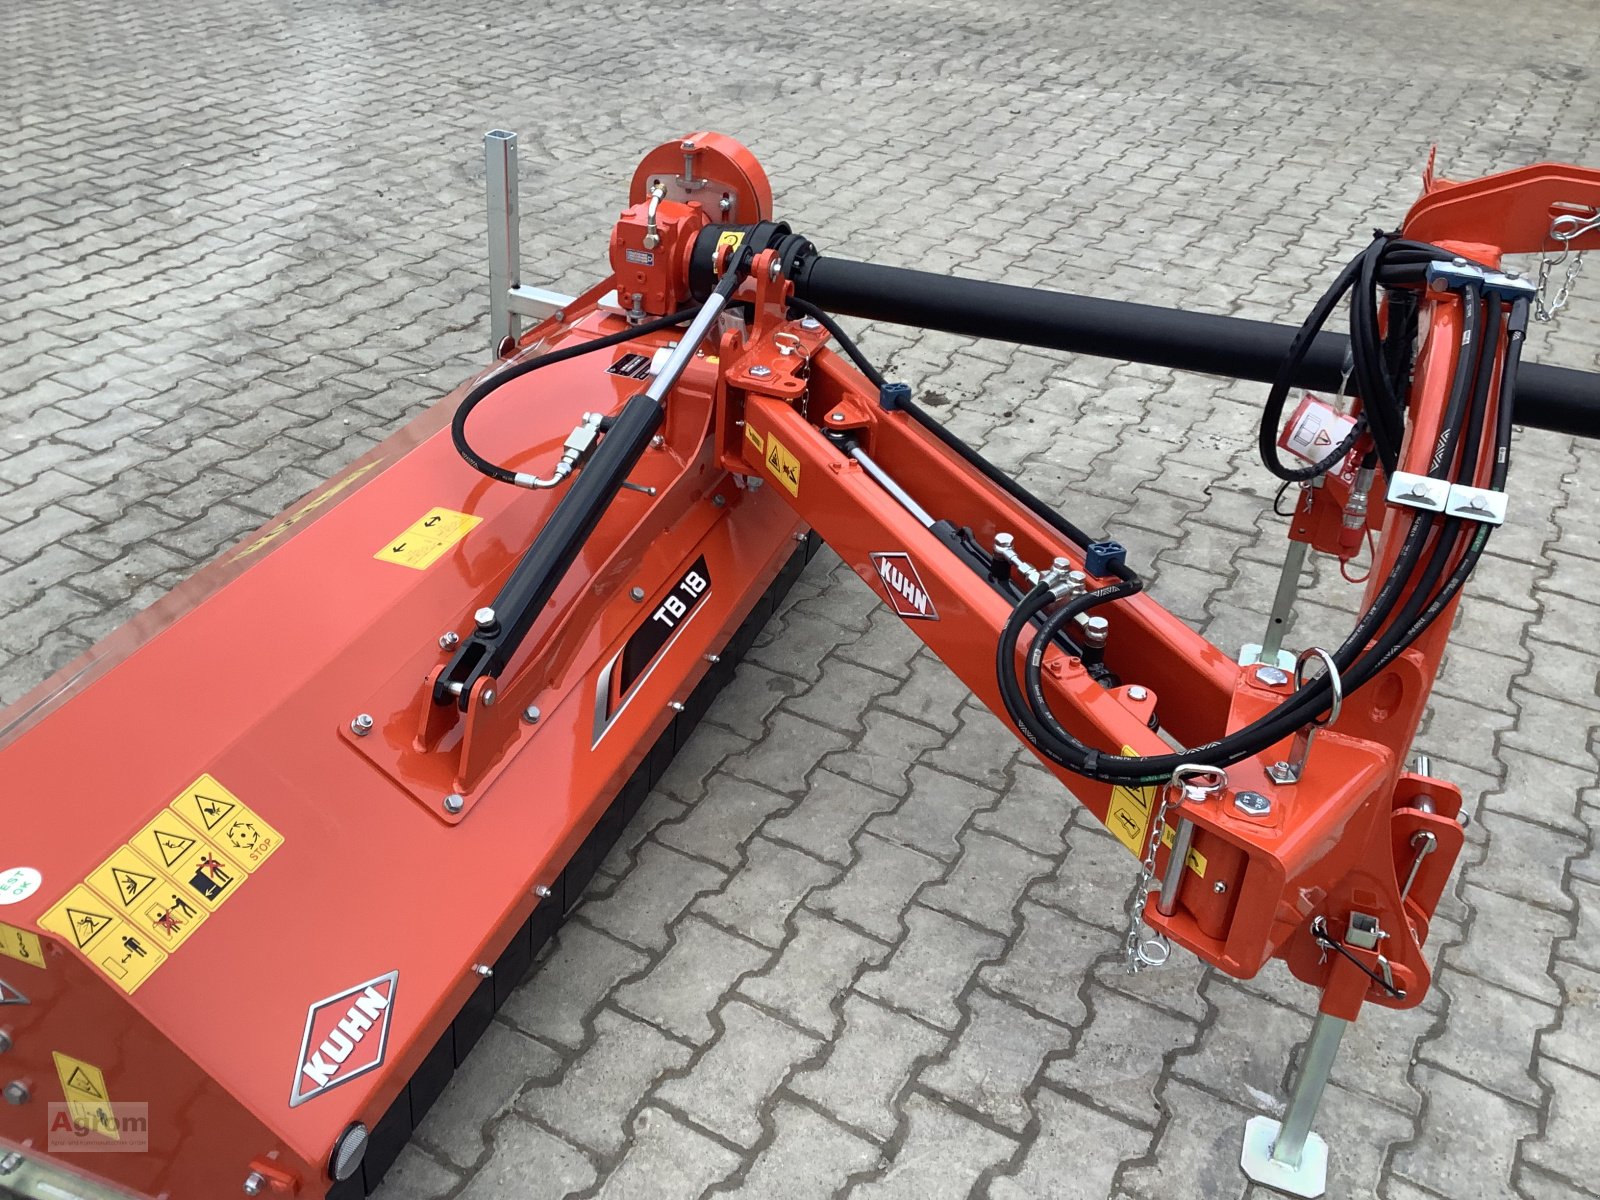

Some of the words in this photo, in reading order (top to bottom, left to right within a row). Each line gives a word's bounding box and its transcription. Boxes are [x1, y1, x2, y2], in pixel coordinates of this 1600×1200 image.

[653, 595, 687, 628] TB
[680, 571, 707, 598] 18
[881, 556, 928, 615] KUHN
[250, 838, 271, 861] STOP
[0, 870, 24, 891] EST
[13, 881, 32, 895] OK
[302, 985, 389, 1088] KUHN
